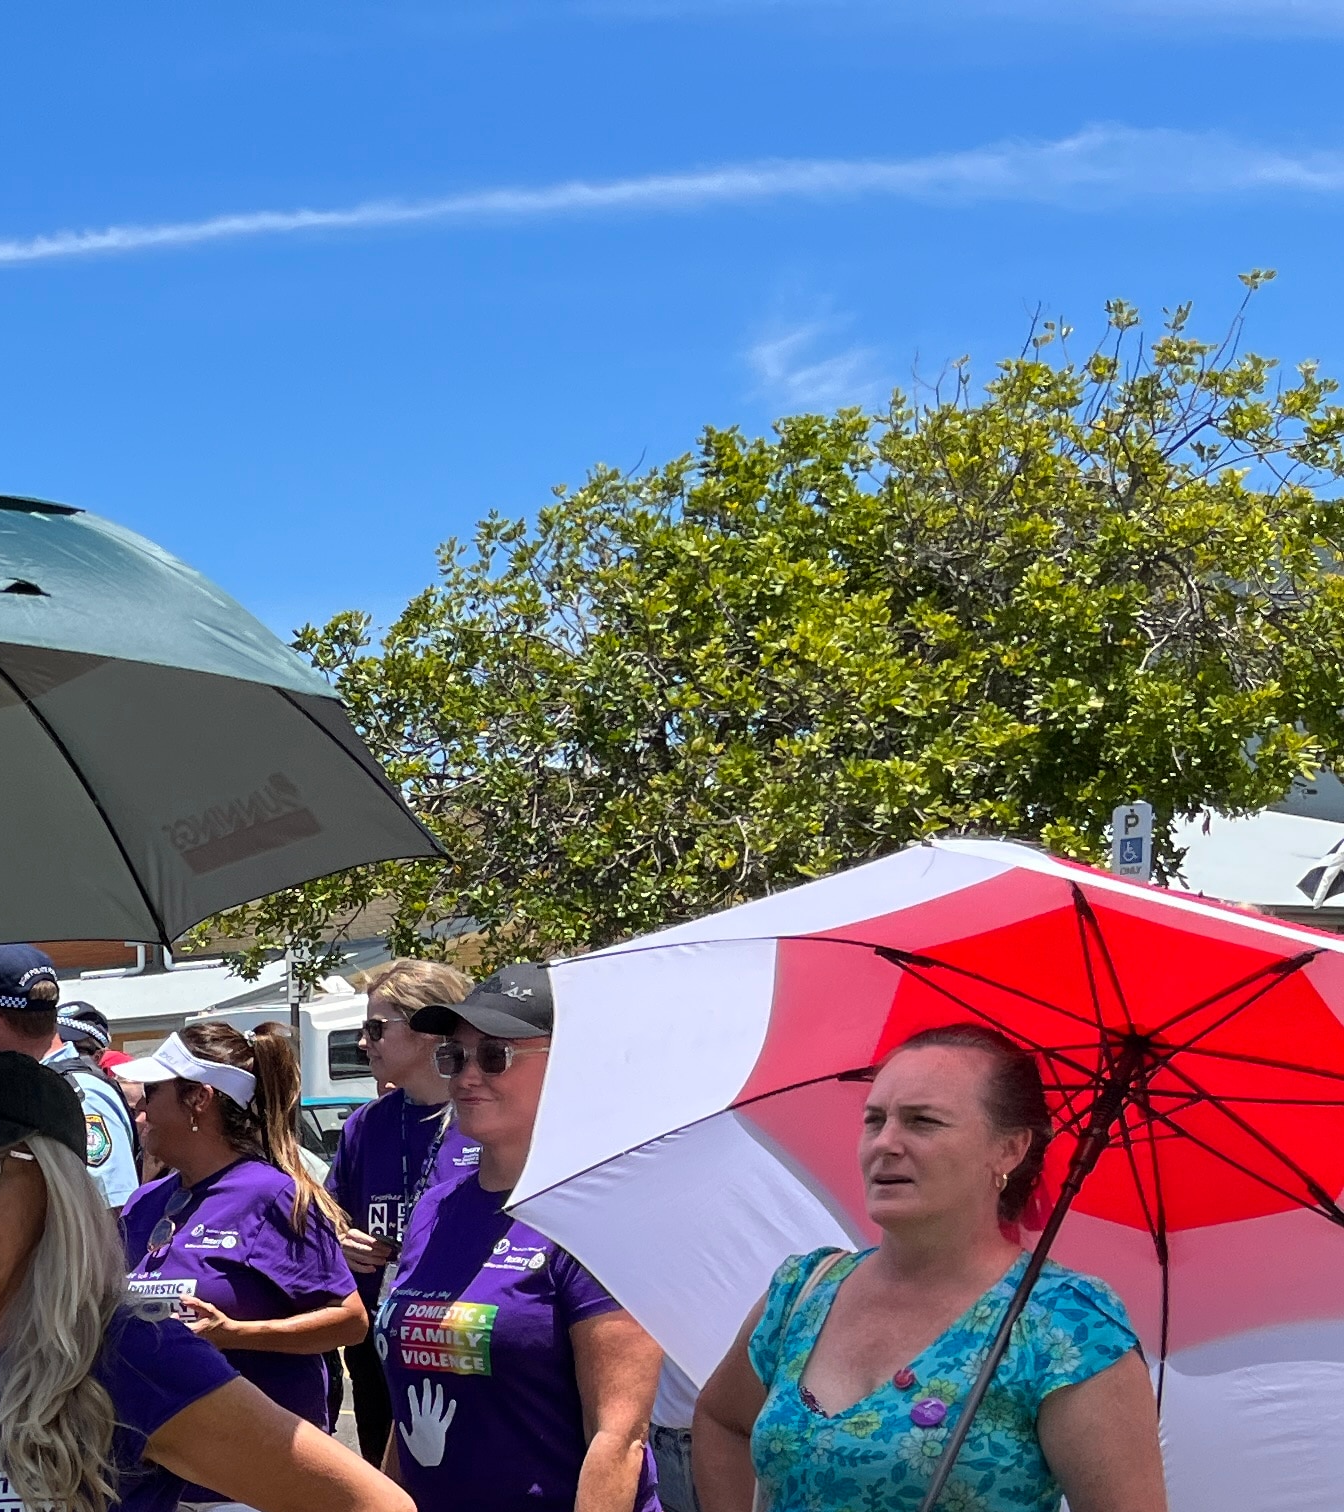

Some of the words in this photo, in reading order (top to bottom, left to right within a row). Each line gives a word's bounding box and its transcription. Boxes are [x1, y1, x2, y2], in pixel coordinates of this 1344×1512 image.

[1125, 813, 1139, 835] P
[405, 1304, 478, 1322] DOMESTIC
[478, 1312, 487, 1324] &
[400, 1326, 484, 1348] FAMILY
[401, 1350, 486, 1371] VIOLENCE
